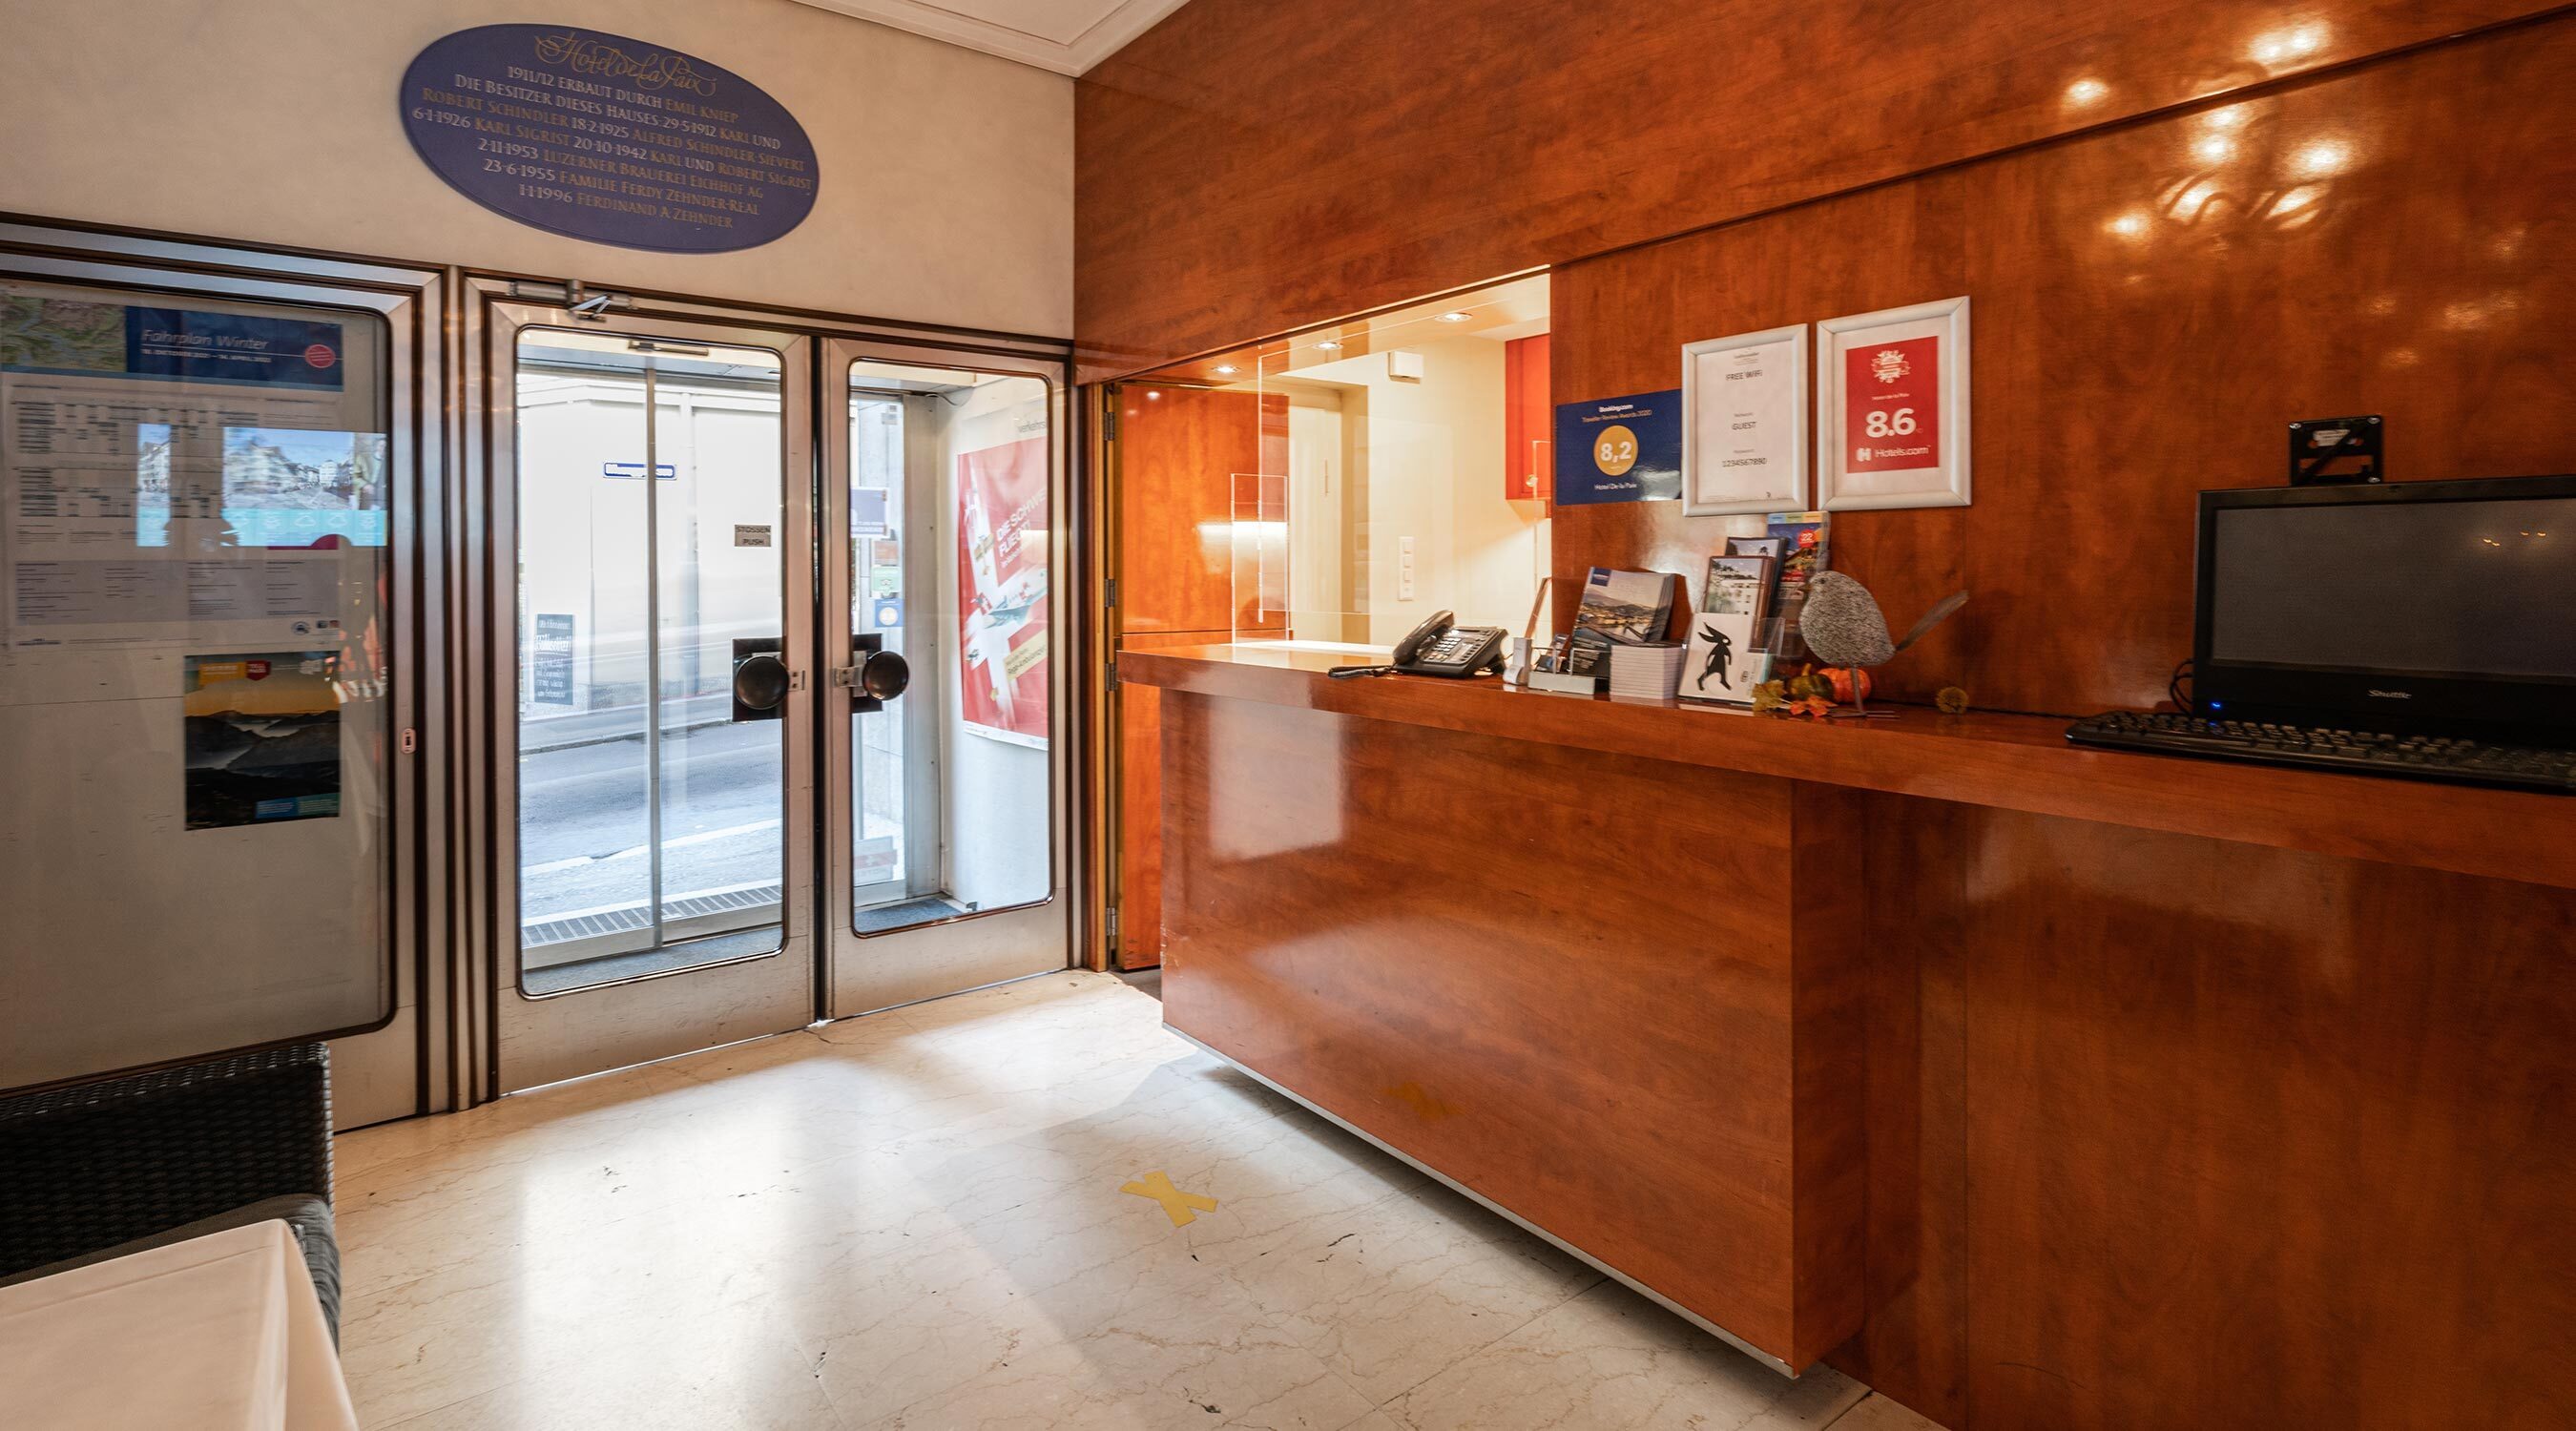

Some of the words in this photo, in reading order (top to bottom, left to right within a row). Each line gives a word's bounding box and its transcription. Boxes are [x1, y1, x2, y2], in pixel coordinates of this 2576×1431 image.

[508, 66, 555, 87] 1911/12
[557, 76, 613, 98] ERBAUT
[616, 89, 661, 109] DURCH
[666, 99, 697, 115] EMIL
[423, 87, 484, 111] ROBERT
[488, 101, 569, 127] SCHINDLER
[633, 128, 683, 148] ALFRED
[455, 73, 481, 91] DIE
[485, 80, 552, 105] BESITZER
[556, 95, 602, 114] DIESES
[719, 128, 749, 143] KARL
[753, 135, 781, 150] UND
[474, 117, 512, 135] KARL
[516, 124, 571, 146] SIGRIST
[651, 150, 681, 167] KARL
[685, 156, 715, 172] UND
[717, 163, 763, 181] ROBERT
[543, 149, 616, 174] LUZERNER
[620, 163, 687, 185] BRAUEREI
[690, 175, 743, 195] EICHHOF
[559, 171, 617, 192] FAMILIE
[621, 180, 662, 199] FERDY
[576, 193, 657, 216] FERDINAND
[673, 207, 733, 229] ZEHNDER
[142, 329, 213, 346] Fahrplan
[217, 335, 268, 349] Winter
[1725, 372, 1743, 381] FREE
[1732, 422, 1755, 430] GUEST
[1865, 407, 1917, 438] 8.6
[1600, 441, 1632, 463] 8,2
[1875, 446, 1929, 458] Hotels.com
[2367, 689, 2412, 699] Shuttle
